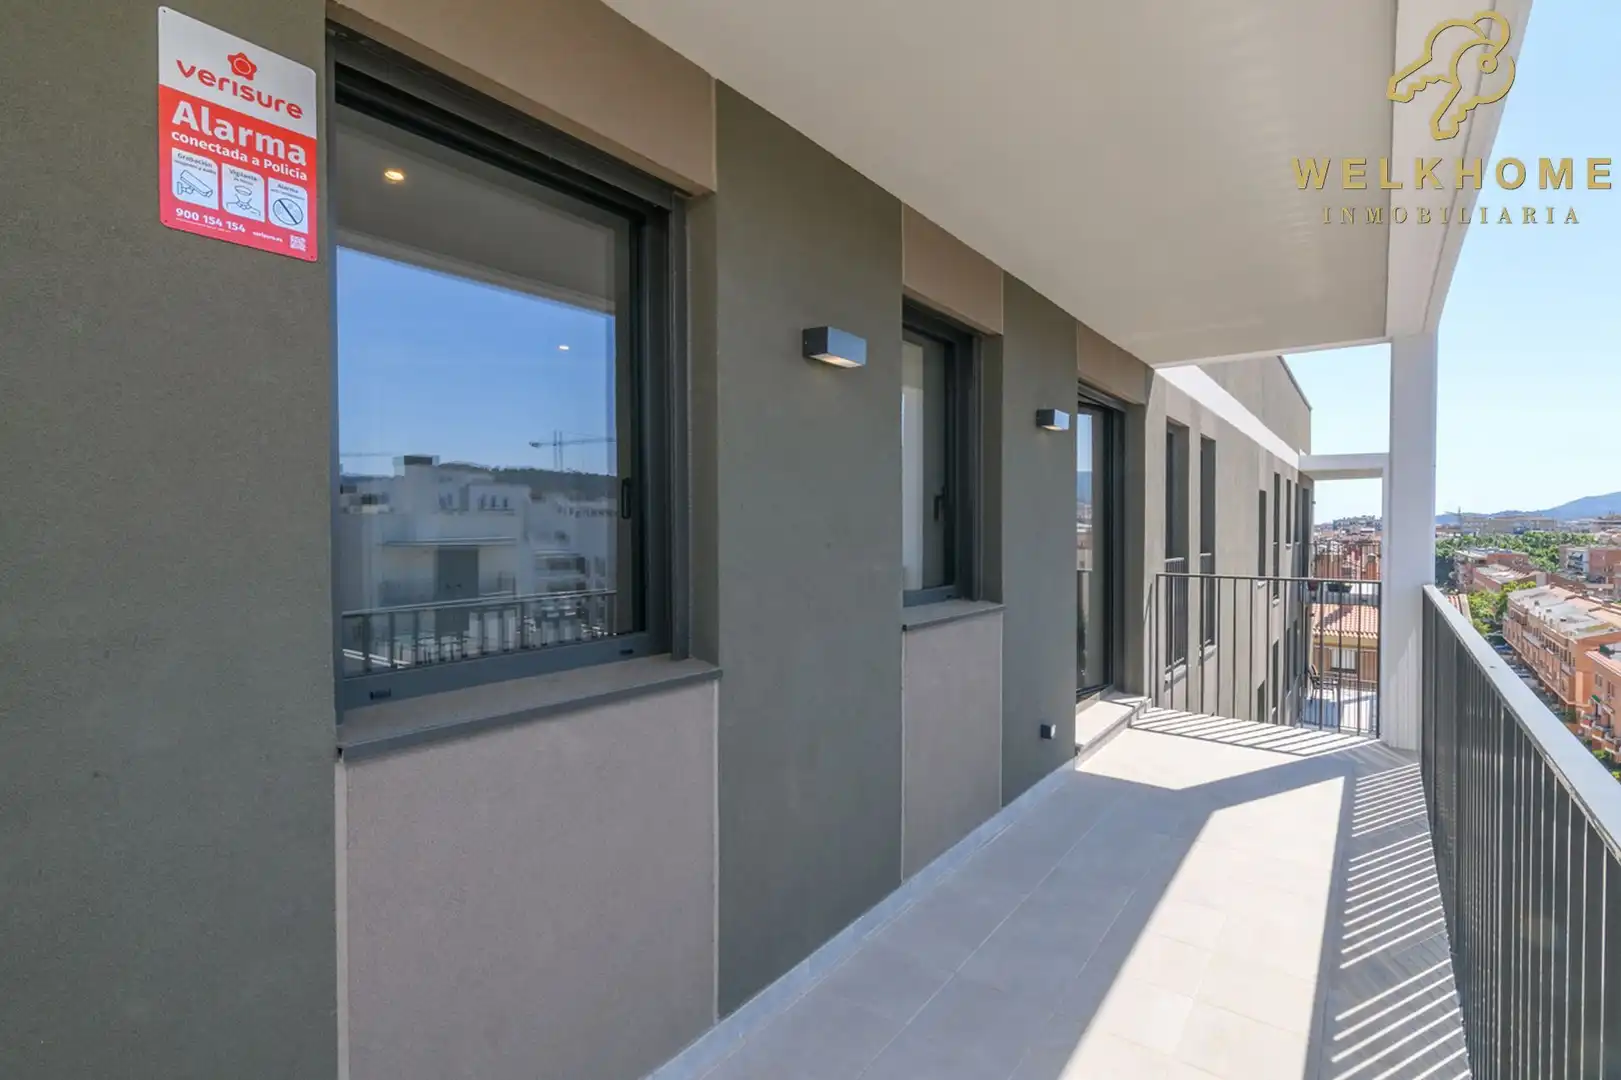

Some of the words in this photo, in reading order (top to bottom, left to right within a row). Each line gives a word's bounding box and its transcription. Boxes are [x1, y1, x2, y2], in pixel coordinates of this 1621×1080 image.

[176, 59, 303, 119] verisure
[171, 100, 307, 166] Alarma
[171, 131, 249, 162] conectada
[252, 156, 261, 166] a
[175, 207, 202, 222] 900
[203, 214, 223, 228] 154
[225, 219, 246, 233] 154
